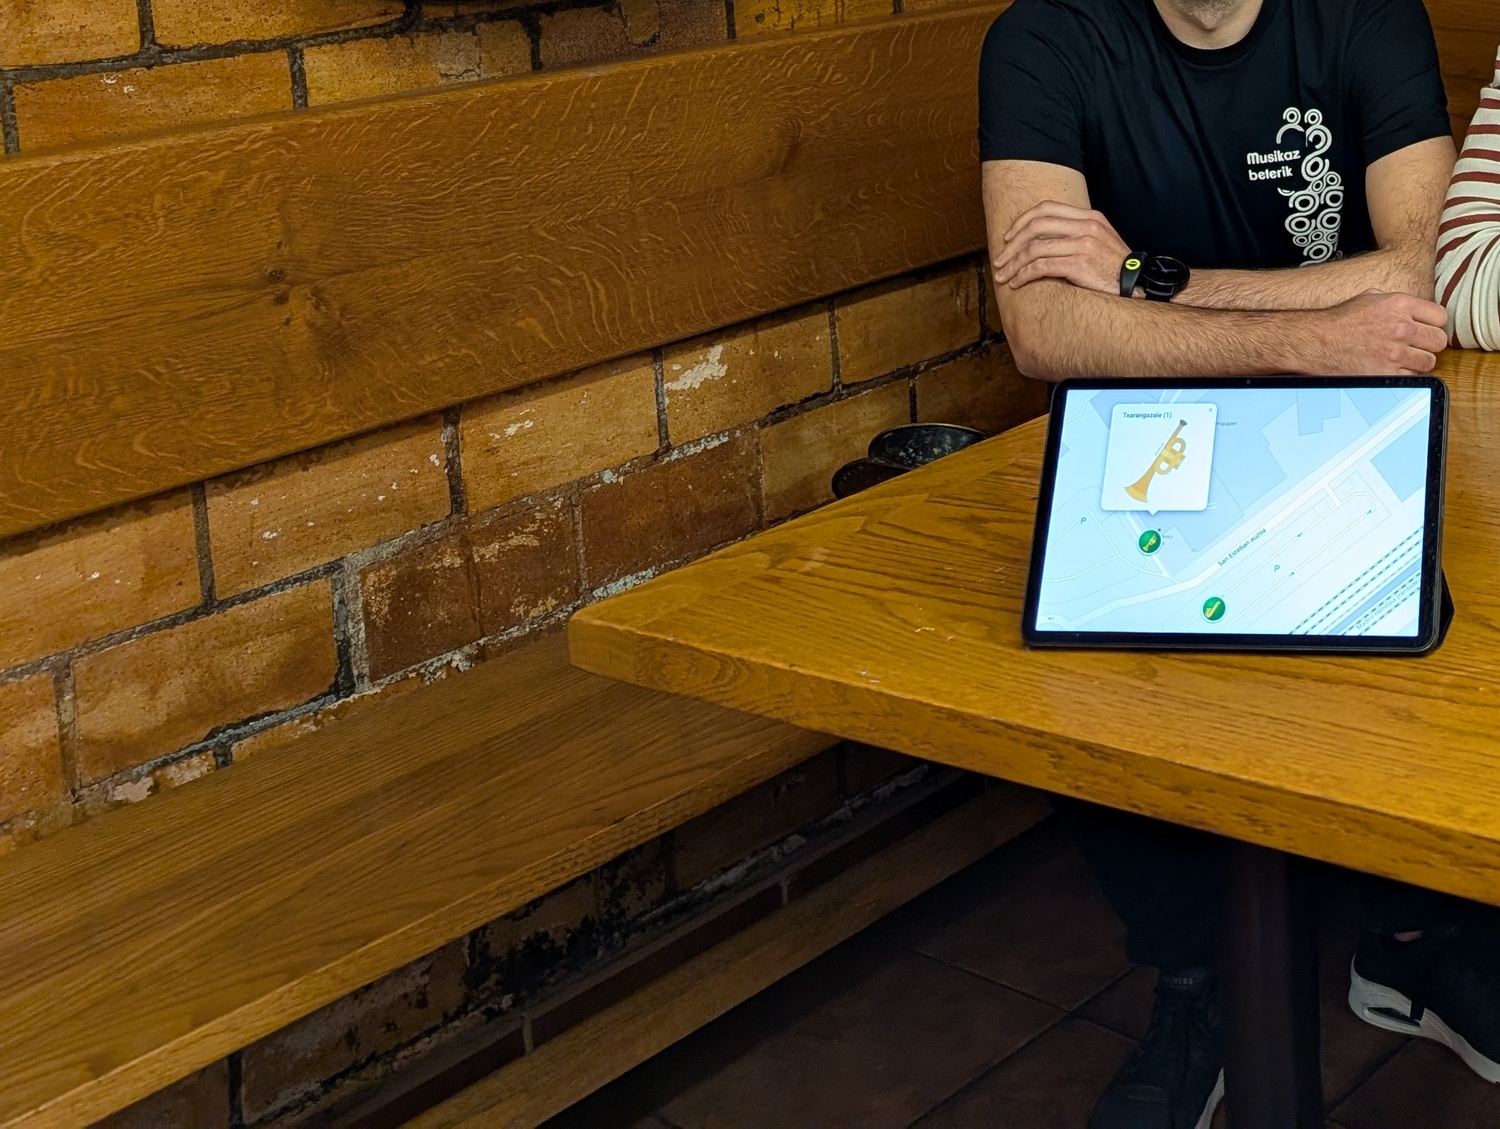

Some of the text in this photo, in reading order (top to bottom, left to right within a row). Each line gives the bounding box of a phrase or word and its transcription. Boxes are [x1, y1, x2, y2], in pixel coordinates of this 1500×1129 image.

[1246, 150, 1301, 165] Musikaz
[1248, 165, 1293, 181] beterik
[1217, 556, 1229, 566] San
[1228, 541, 1250, 558] Esteban
